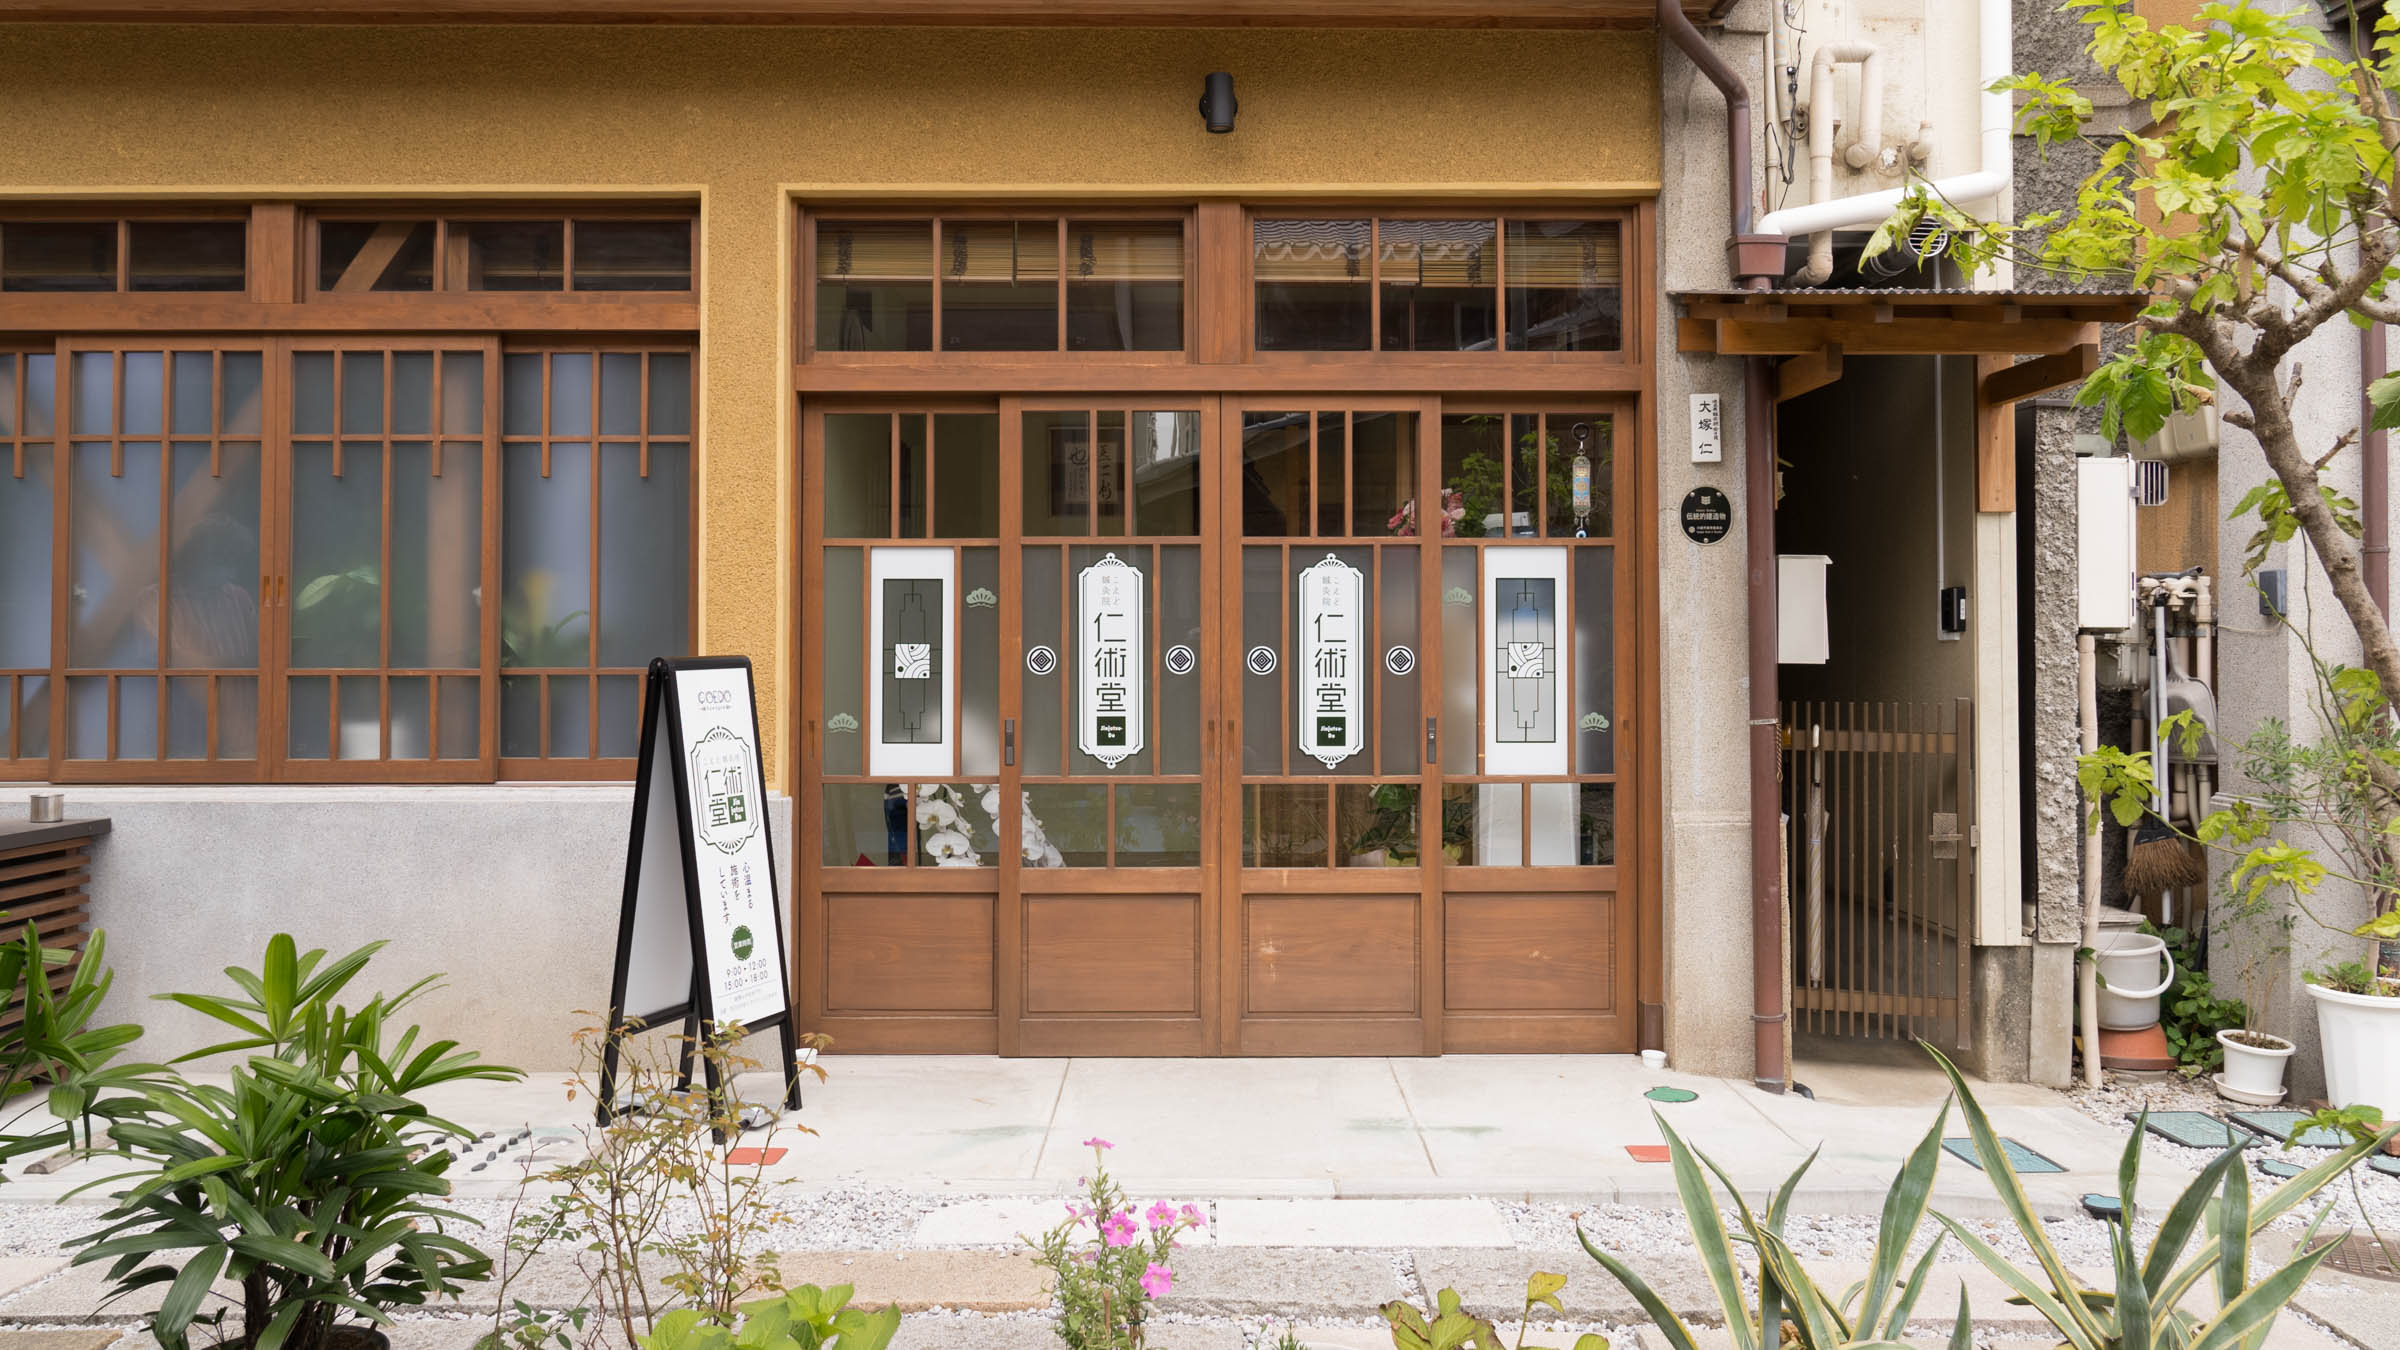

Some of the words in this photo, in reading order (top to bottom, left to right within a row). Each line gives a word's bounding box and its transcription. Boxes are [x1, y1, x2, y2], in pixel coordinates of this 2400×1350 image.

[1094, 612, 1127, 712] 仁術堂
[1314, 612, 1347, 713] 仁術堂
[697, 690, 732, 704] COEDO
[730, 864, 740, 901] 施術を
[743, 862, 753, 909] 心温まる
